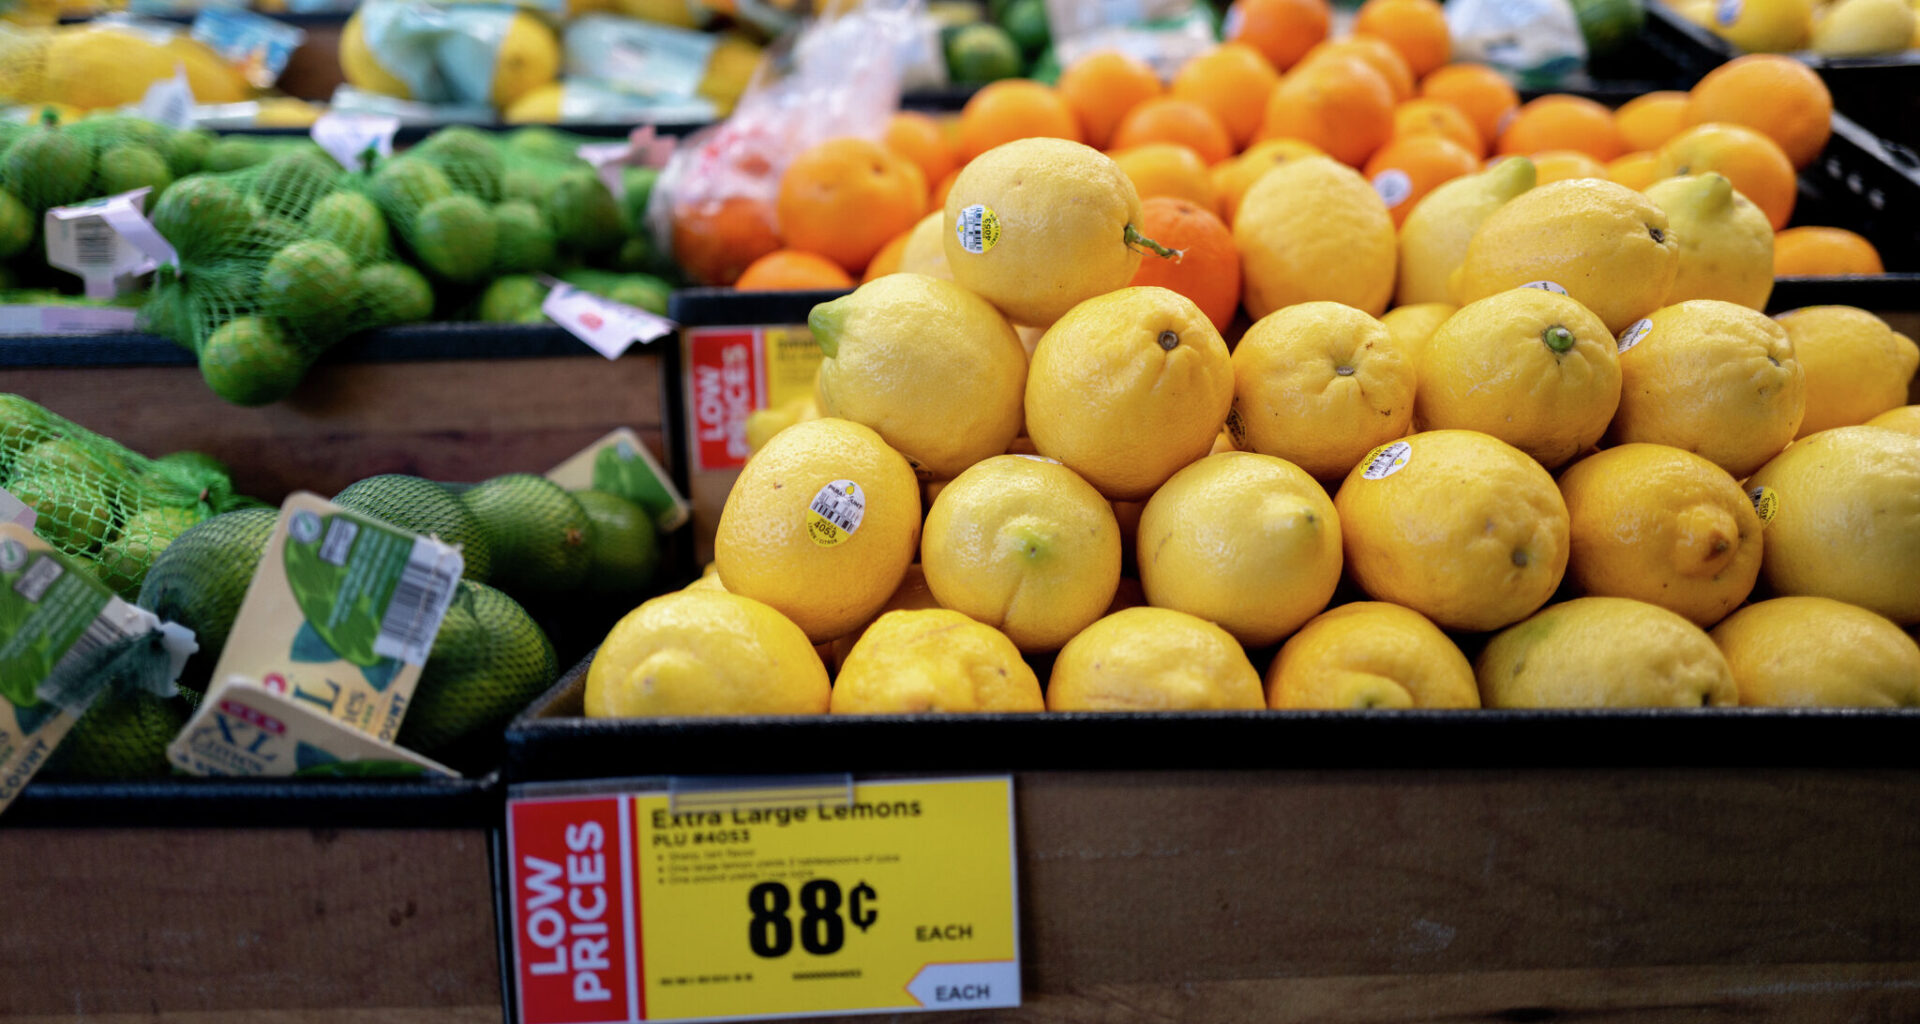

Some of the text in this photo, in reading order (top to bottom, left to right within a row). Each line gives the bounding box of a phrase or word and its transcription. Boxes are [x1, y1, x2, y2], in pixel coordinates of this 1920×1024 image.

[697, 364, 725, 441] LOW
[828, 483, 863, 510] PARAUNT
[814, 521, 837, 539] 4053
[378, 692, 406, 743] OUNT
[652, 799, 922, 829] Extra Large Lemons
[653, 829, 751, 848] PLU #4053
[524, 855, 568, 975] LOW
[565, 820, 611, 1003] PRICES
[915, 925, 973, 941] EACH
[935, 984, 990, 1002] EACH
